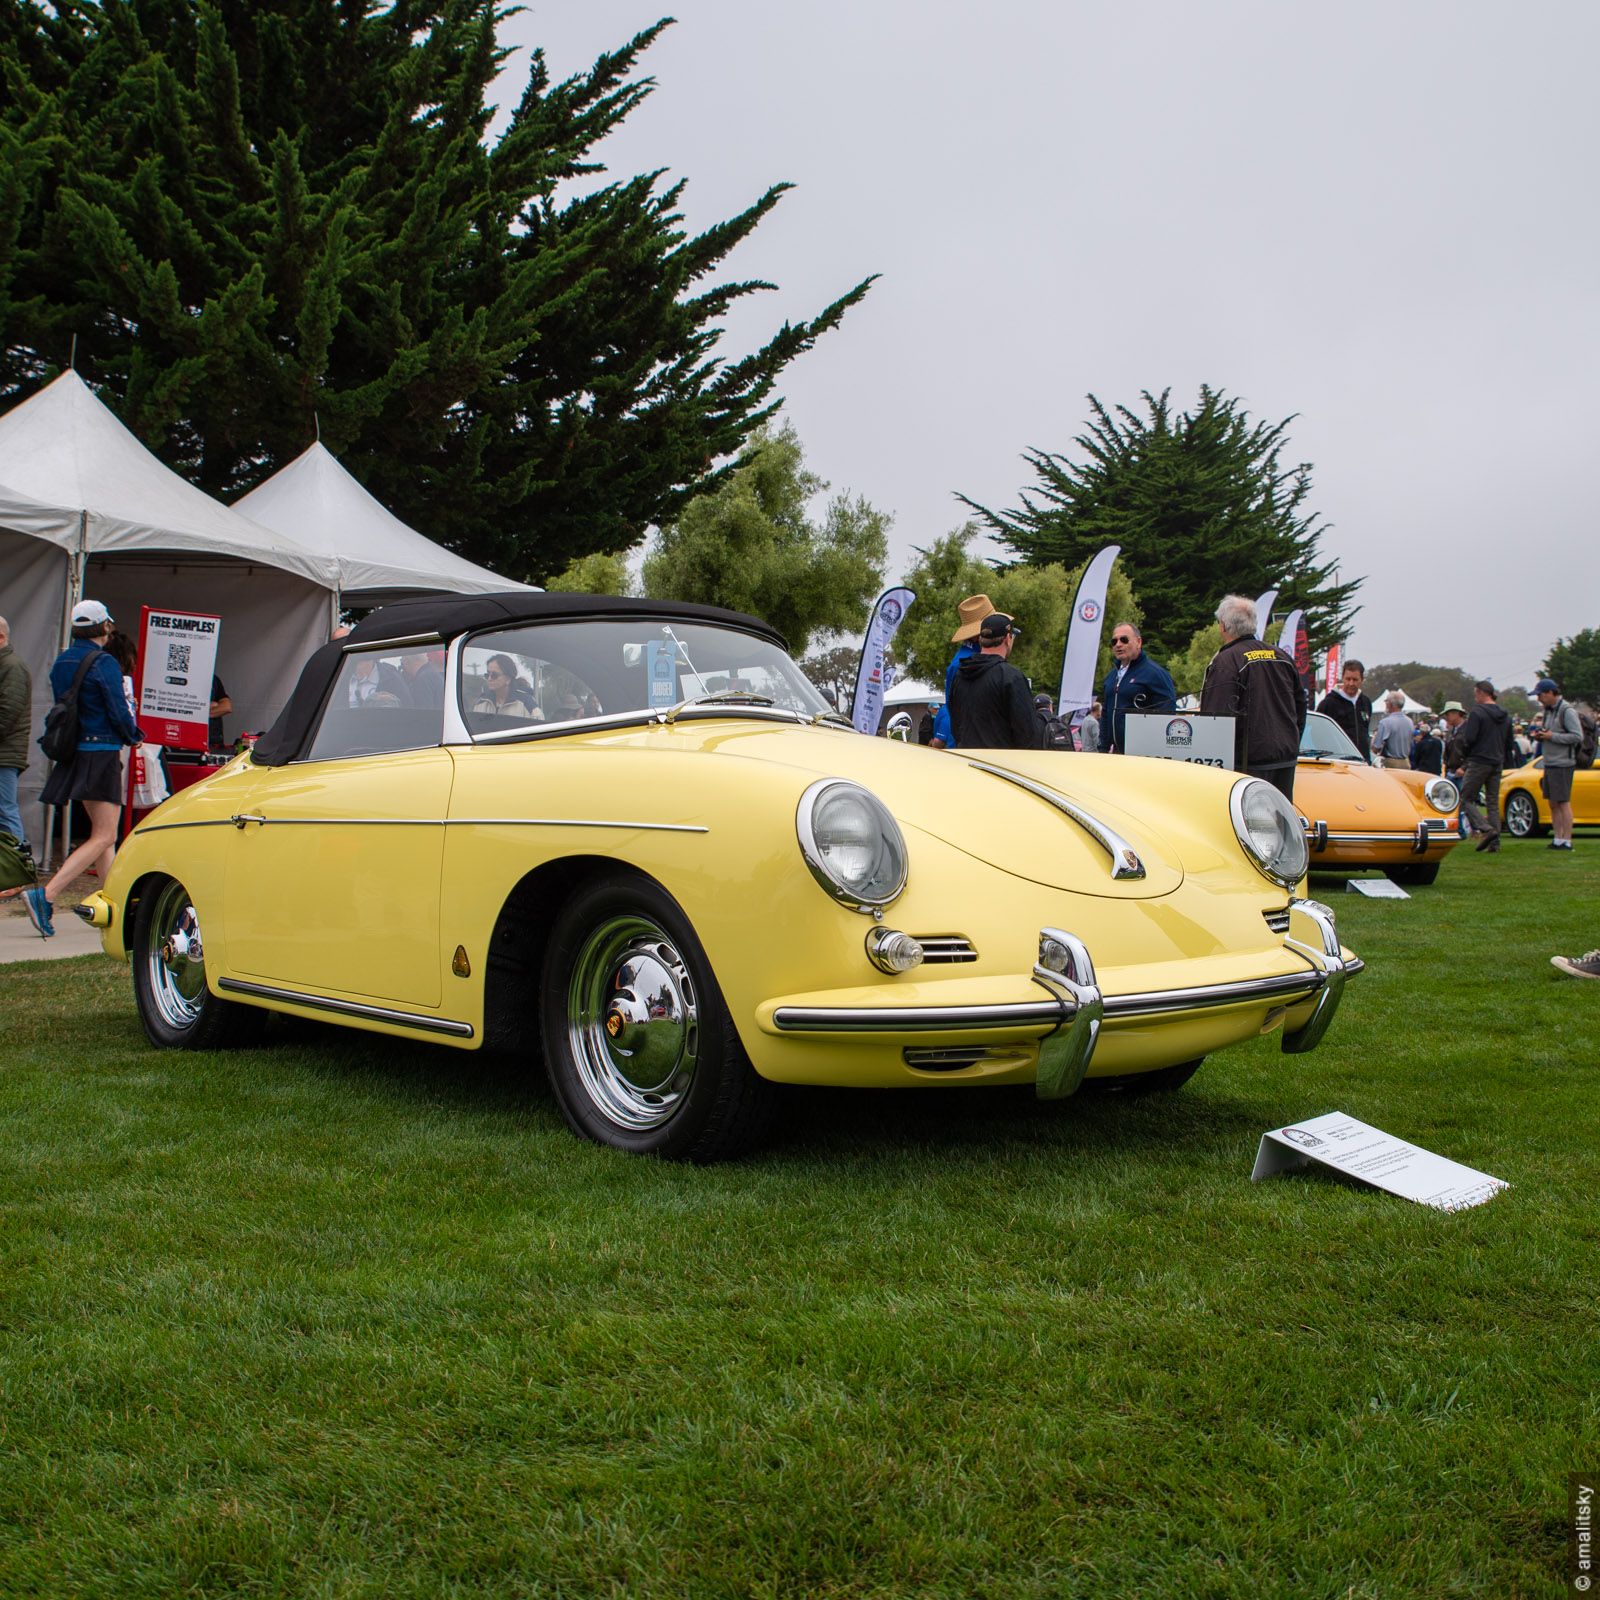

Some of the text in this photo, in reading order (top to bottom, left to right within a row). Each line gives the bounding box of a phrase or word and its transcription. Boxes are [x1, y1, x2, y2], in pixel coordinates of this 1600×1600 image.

[151, 616, 215, 633] FREE SAMPLES!
[1243, 649, 1277, 661] Ferrari
